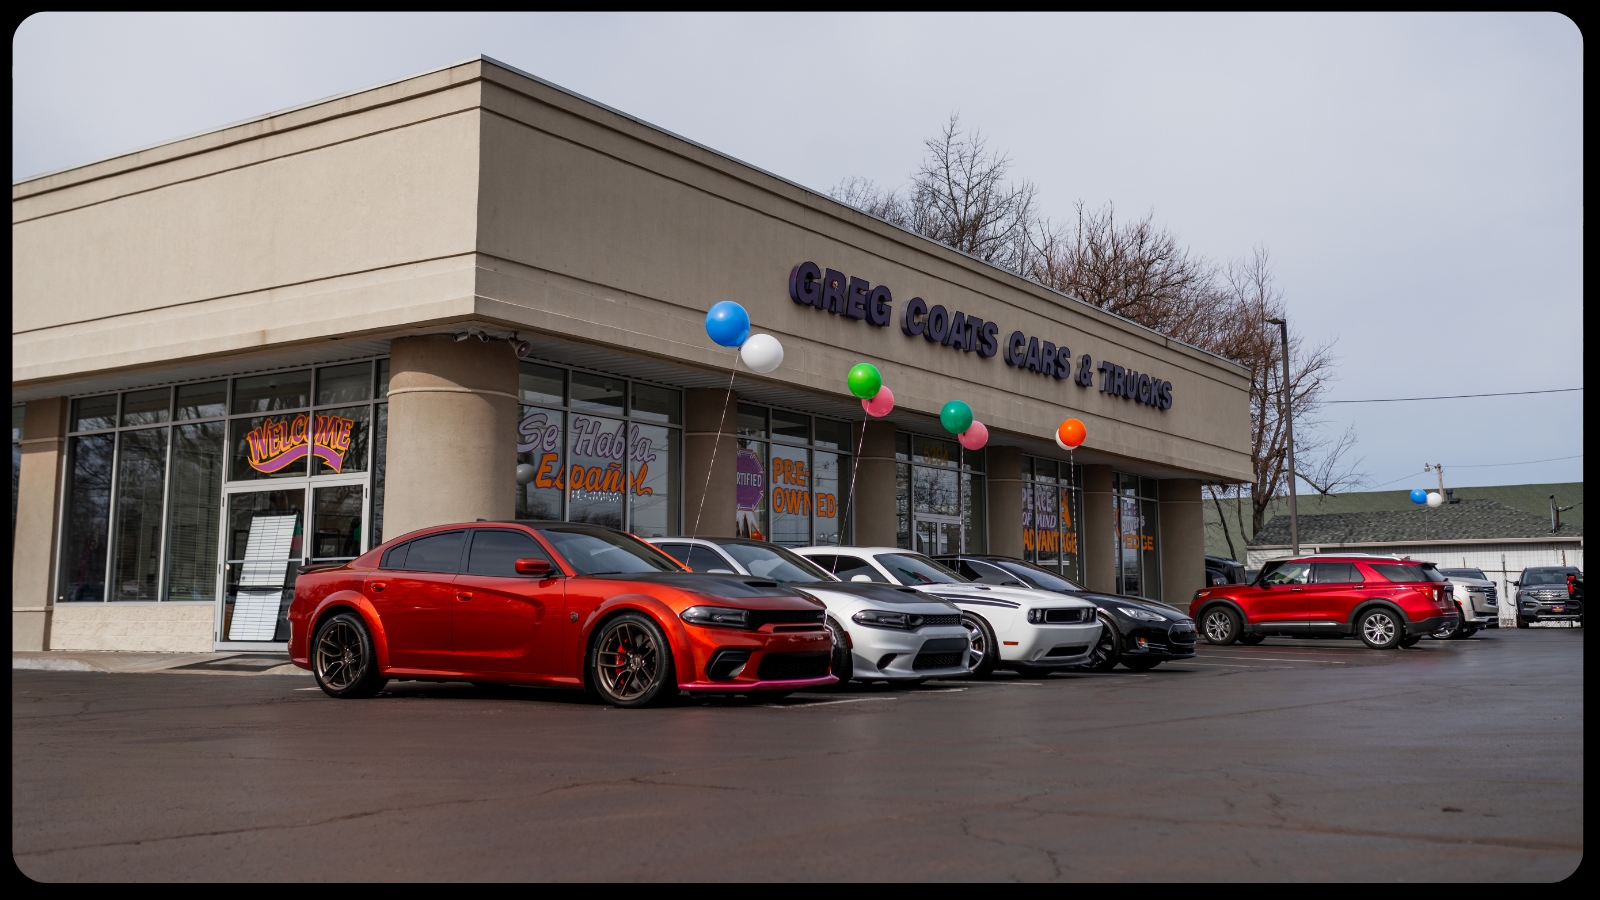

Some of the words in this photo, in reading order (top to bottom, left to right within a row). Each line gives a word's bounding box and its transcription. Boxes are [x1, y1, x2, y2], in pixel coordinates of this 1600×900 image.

[789, 261, 892, 327] GREG
[901, 296, 998, 358] COATS
[1004, 330, 1070, 380] CARS
[1075, 353, 1093, 387] &
[1098, 360, 1173, 410] TRUCKS
[246, 414, 354, 464] WELCOME
[517, 413, 559, 453] Se
[573, 416, 657, 462] Habla
[923, 445, 949, 467] 5204
[535, 452, 653, 501] Español
[736, 471, 763, 488] RTIFIED
[773, 457, 812, 486] PRE-
[773, 487, 837, 518] OWNED
[1022, 487, 1053, 513] PEACE
[1023, 528, 1077, 554] ADVANTAGE
[1126, 533, 1154, 551] EDGE
